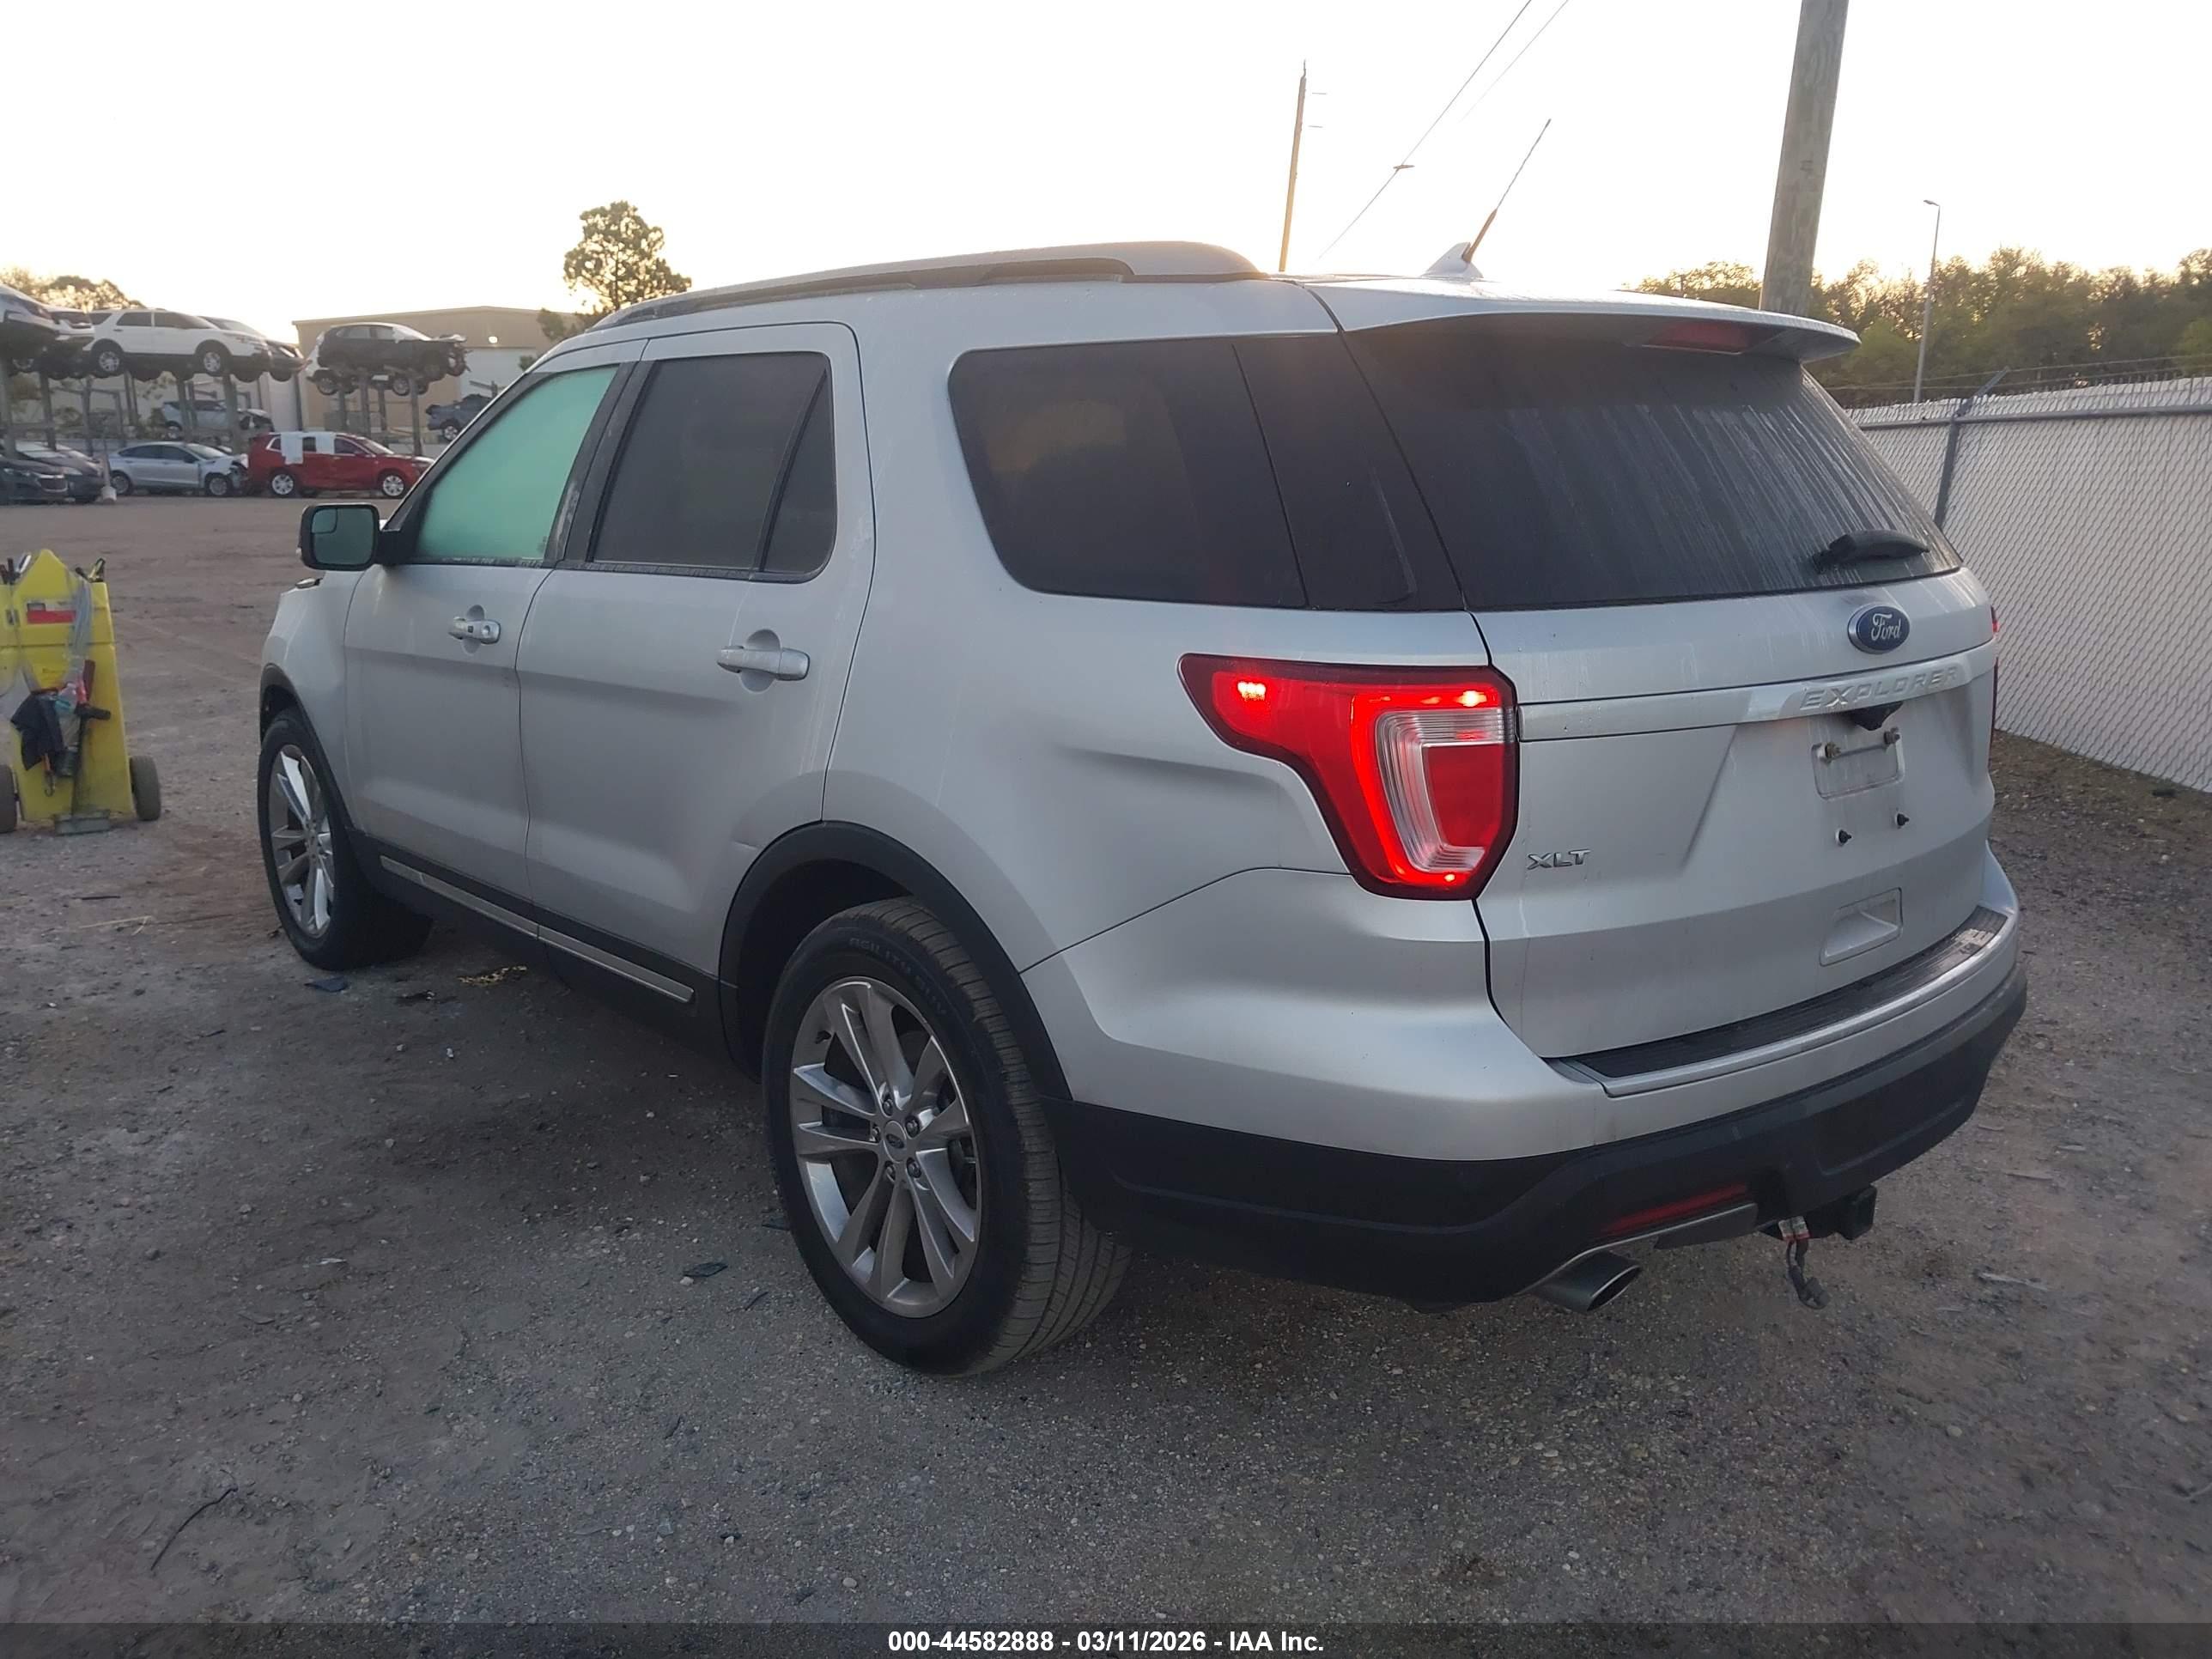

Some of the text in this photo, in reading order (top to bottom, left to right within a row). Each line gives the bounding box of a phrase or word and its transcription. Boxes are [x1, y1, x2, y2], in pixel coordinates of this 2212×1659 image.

[1870, 612, 1902, 641] Ford
[1799, 665, 1960, 711] EXPLORER
[1526, 848, 1591, 871] XLT
